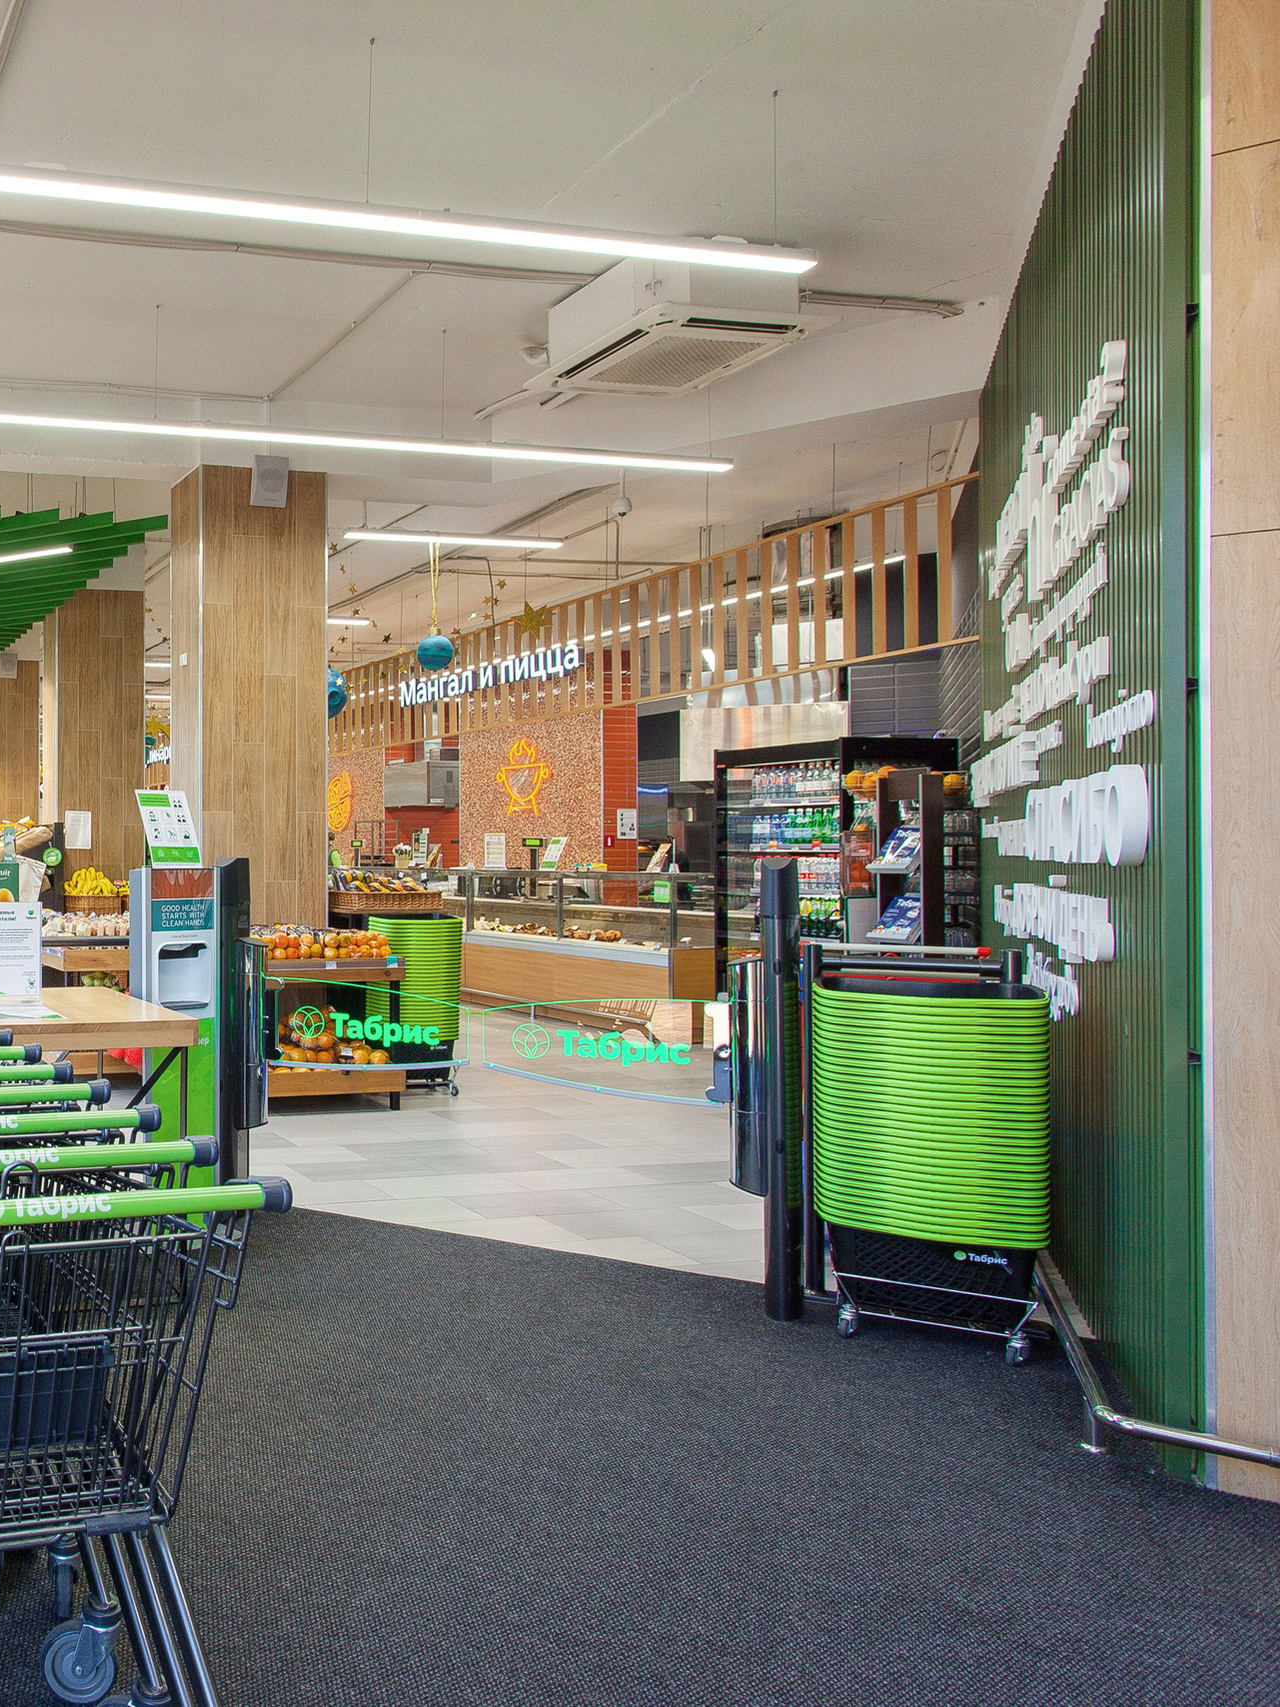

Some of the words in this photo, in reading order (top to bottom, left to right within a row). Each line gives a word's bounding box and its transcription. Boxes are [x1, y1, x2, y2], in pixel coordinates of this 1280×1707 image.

[399, 669, 473, 708] Мангал
[480, 666, 494, 690] и
[499, 643, 583, 684] пицца
[1025, 763, 1150, 867] СПАСИБО
[161, 904, 181, 912] GOOD
[182, 903, 205, 911] HEALTH
[161, 912, 187, 920] STARTS
[189, 911, 205, 919] WITH
[329, 1012, 440, 1048] Табрис
[556, 1029, 691, 1068] Табрис
[967, 1252, 1008, 1265] Табрис
